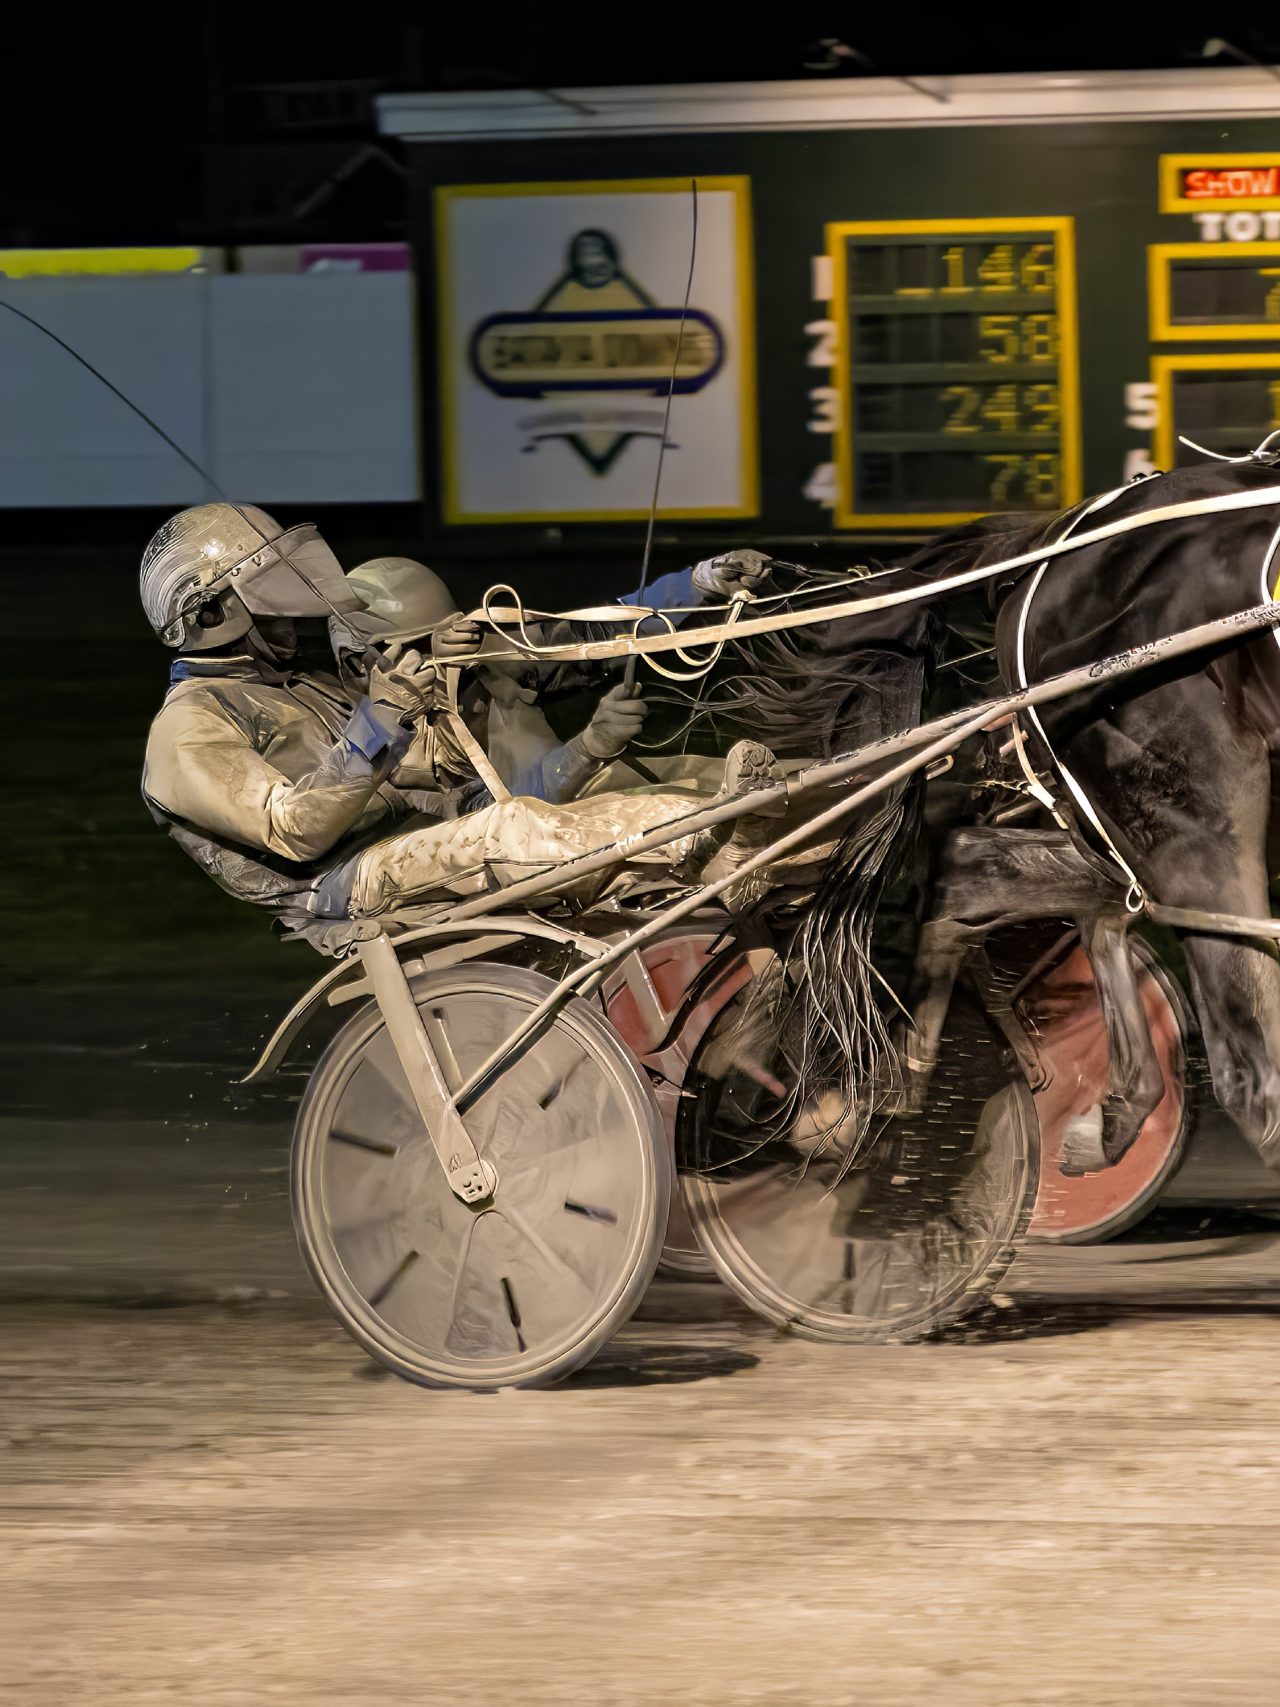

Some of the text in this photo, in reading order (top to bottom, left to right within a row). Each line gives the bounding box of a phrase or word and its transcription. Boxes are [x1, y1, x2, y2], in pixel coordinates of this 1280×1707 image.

[1184, 168, 1280, 198] SHOW
[804, 320, 838, 367] 2
[978, 314, 1057, 363] 58
[806, 386, 840, 433] 3
[938, 384, 1058, 434] 249
[1124, 382, 1161, 430] 5
[803, 462, 839, 508] 4
